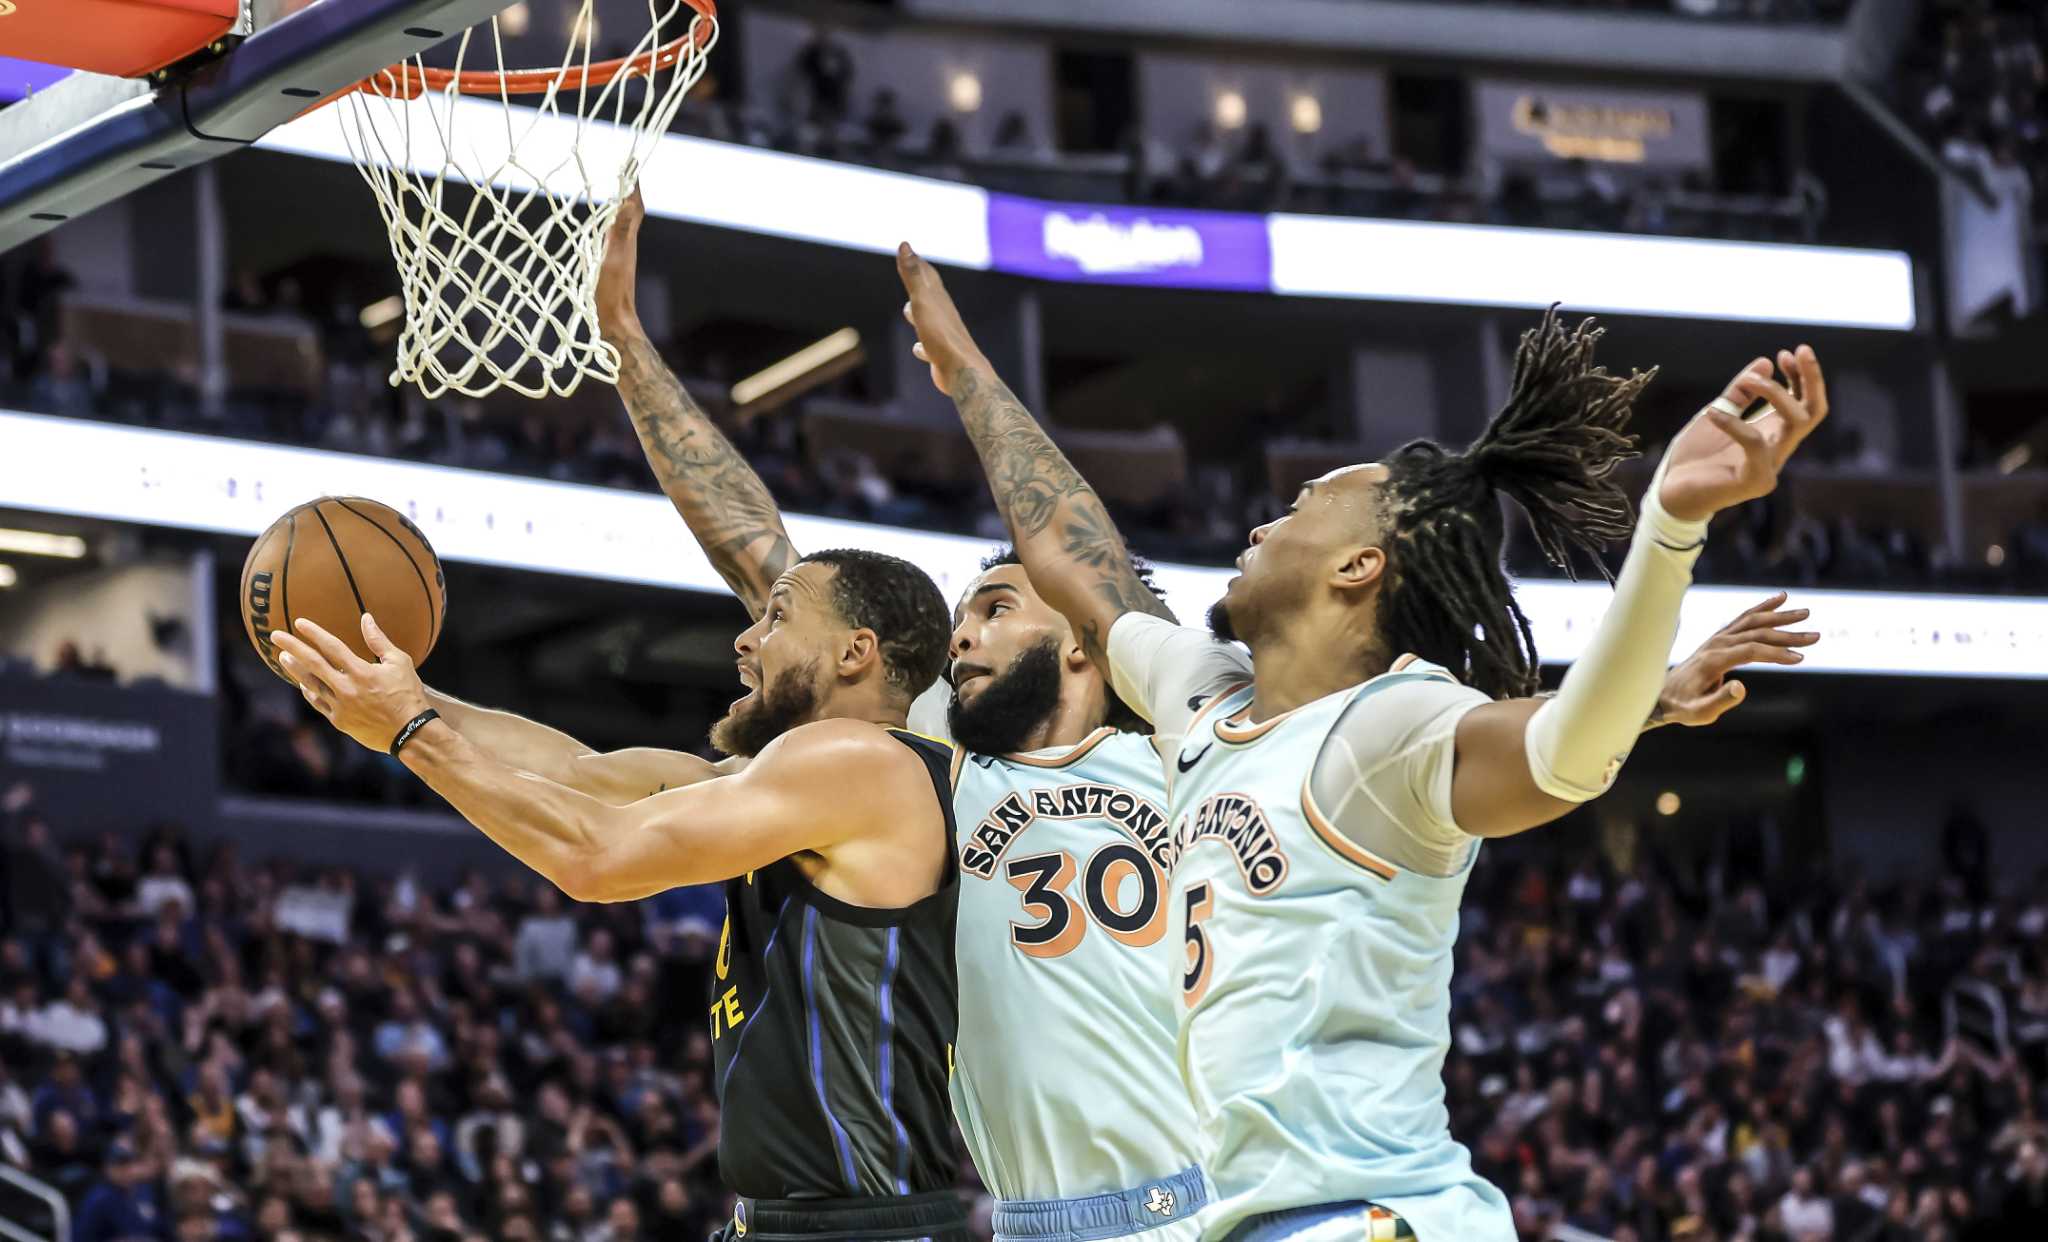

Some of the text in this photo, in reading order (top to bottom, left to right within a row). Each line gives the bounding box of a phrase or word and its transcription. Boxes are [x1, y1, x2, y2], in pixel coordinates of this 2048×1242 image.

[962, 793, 1033, 878] SAN
[1190, 796, 1287, 892] ANTONIO
[1006, 844, 1167, 957] 30
[1183, 880, 1212, 1005] 5
[710, 985, 745, 1040] TE
